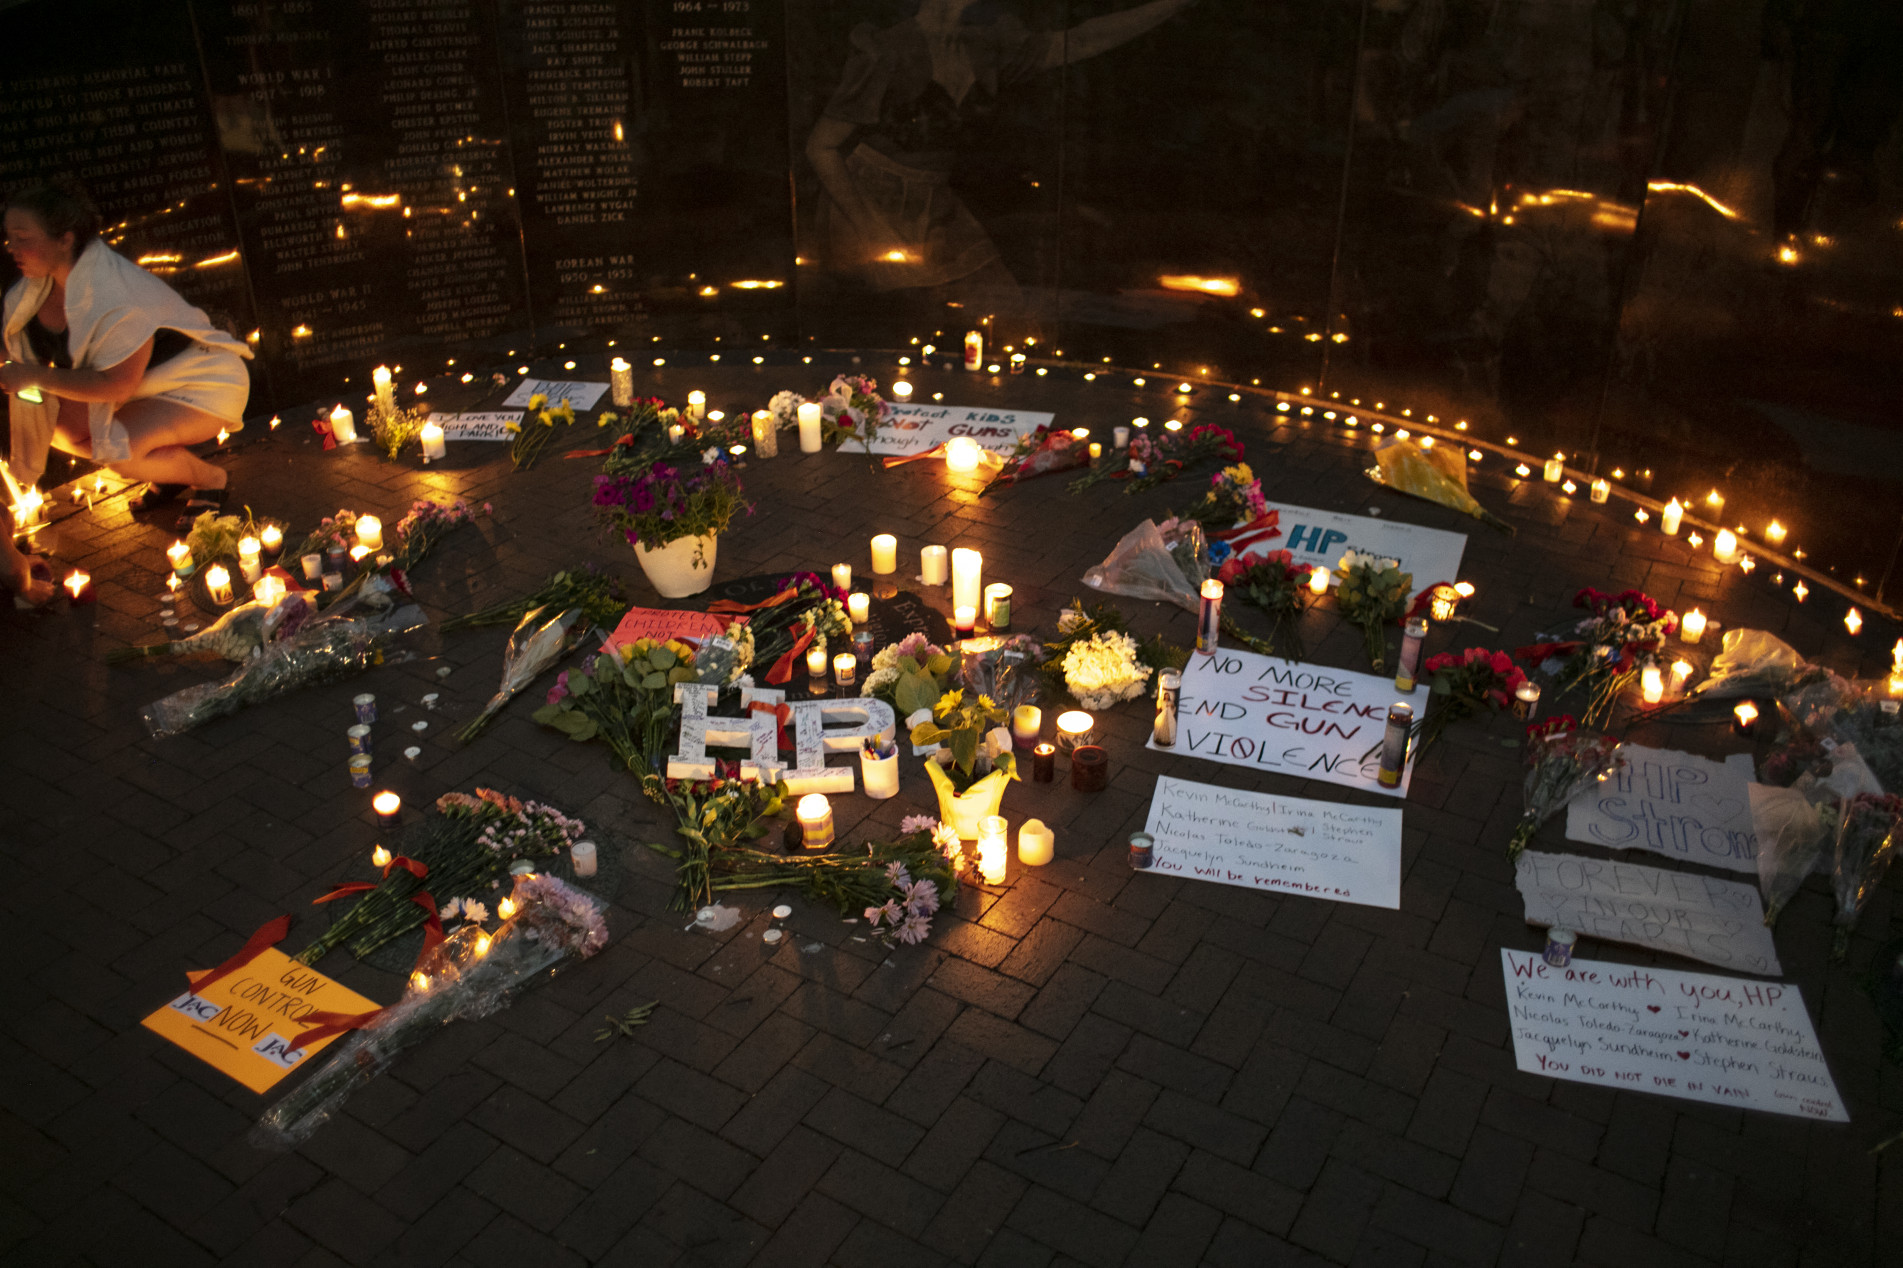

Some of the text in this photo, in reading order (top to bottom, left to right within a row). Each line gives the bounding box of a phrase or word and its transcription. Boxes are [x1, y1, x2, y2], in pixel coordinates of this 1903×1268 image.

[523, 5, 565, 15] FRANCIS
[673, 2, 750, 12] 1964 1973
[526, 18, 558, 28] JAMES
[380, 25, 423, 36] THOMAS
[672, 28, 752, 36] FRANK KOLBECK
[369, 39, 408, 50] ALFRED
[532, 42, 617, 54] JACK SHARPLESS
[660, 40, 768, 50] GEORGE SCHWALBACH
[384, 49, 467, 63] CHARLES CLARK
[547, 57, 567, 66] RAY
[82, 63, 186, 84] MEMORIAL PARK
[238, 68, 320, 85] WORLD WAR
[528, 70, 581, 79] FREDERICK
[680, 66, 752, 75] JOHN STULLER
[384, 78, 432, 90] LEONARD
[526, 82, 567, 92] DONALD
[683, 78, 749, 87] ROBERT TAFT
[60, 81, 192, 107] TO THOSE RESIDENTS
[299, 84, 325, 97] 1918
[383, 92, 415, 103] PHILIP
[529, 93, 629, 105] MILTON TILLMAN
[107, 98, 196, 118] THE ULTIMATE
[394, 104, 431, 115] JOSEPH
[534, 108, 572, 117] EUGENE
[24, 133, 75, 150] SERVICE
[101, 123, 136, 139] THEIR
[142, 115, 199, 132] COUNTRY
[403, 131, 430, 141] JOHN
[549, 132, 577, 141] IRVIN
[39, 154, 63, 169] ALL
[66, 149, 92, 163] THE
[97, 144, 123, 158] MEN
[129, 139, 154, 153] AND
[160, 132, 203, 148] WOMEN
[398, 143, 439, 154] DONALD
[538, 144, 580, 154] MURRAY
[80, 149, 207, 179] CURRENTLY SERVING
[537, 155, 594, 166] ALEXANDER
[123, 165, 211, 191] ARMED FORCES
[543, 167, 591, 178] MATTHEW
[537, 180, 571, 190] DANIEL
[536, 192, 578, 202] WILLIAM
[545, 202, 596, 214] LAWRENCE
[557, 212, 625, 224] DANIEL ZICK
[555, 254, 634, 270] KOREAN WAR
[560, 269, 633, 283] 1950 1953
[281, 286, 357, 307] WORLD WAR
[1286, 524, 1348, 554] HP
[624, 619, 714, 632] CHILDREN
[644, 630, 676, 639] NOT
[1198, 655, 1353, 697] NO MORE
[1242, 686, 1386, 722] SILENC
[1178, 697, 1362, 740] END GUN
[1617, 760, 1709, 804] HP
[1162, 780, 1208, 802] Kevin
[1280, 804, 1314, 818] Irina
[1160, 802, 1374, 836] Katherine Stephen
[1155, 820, 1206, 842] Nicolas
[1152, 840, 1305, 873] Jacquelyn Sundheim
[1228, 870, 1244, 881] be
[1531, 855, 1733, 909] FOREVER
[1628, 902, 1693, 929] OUR
[1508, 952, 1550, 979] We
[1565, 968, 1602, 985] are
[1609, 970, 1665, 995] with
[279, 967, 328, 996] GUN
[228, 976, 321, 1030] CONTROL
[1516, 985, 1555, 1003] Kevin
[1674, 1004, 1716, 1024] Irina
[209, 1004, 274, 1040] NOW
[1513, 1005, 1568, 1026] Nicolas
[1517, 1027, 1592, 1055] Jacquelyn
[1693, 1050, 1760, 1074] Stephen
[1580, 1065, 1606, 1077] DID
[1615, 1072, 1642, 1082] NOT
[1654, 1076, 1677, 1088] DIE
[1688, 1082, 1703, 1091] IN
